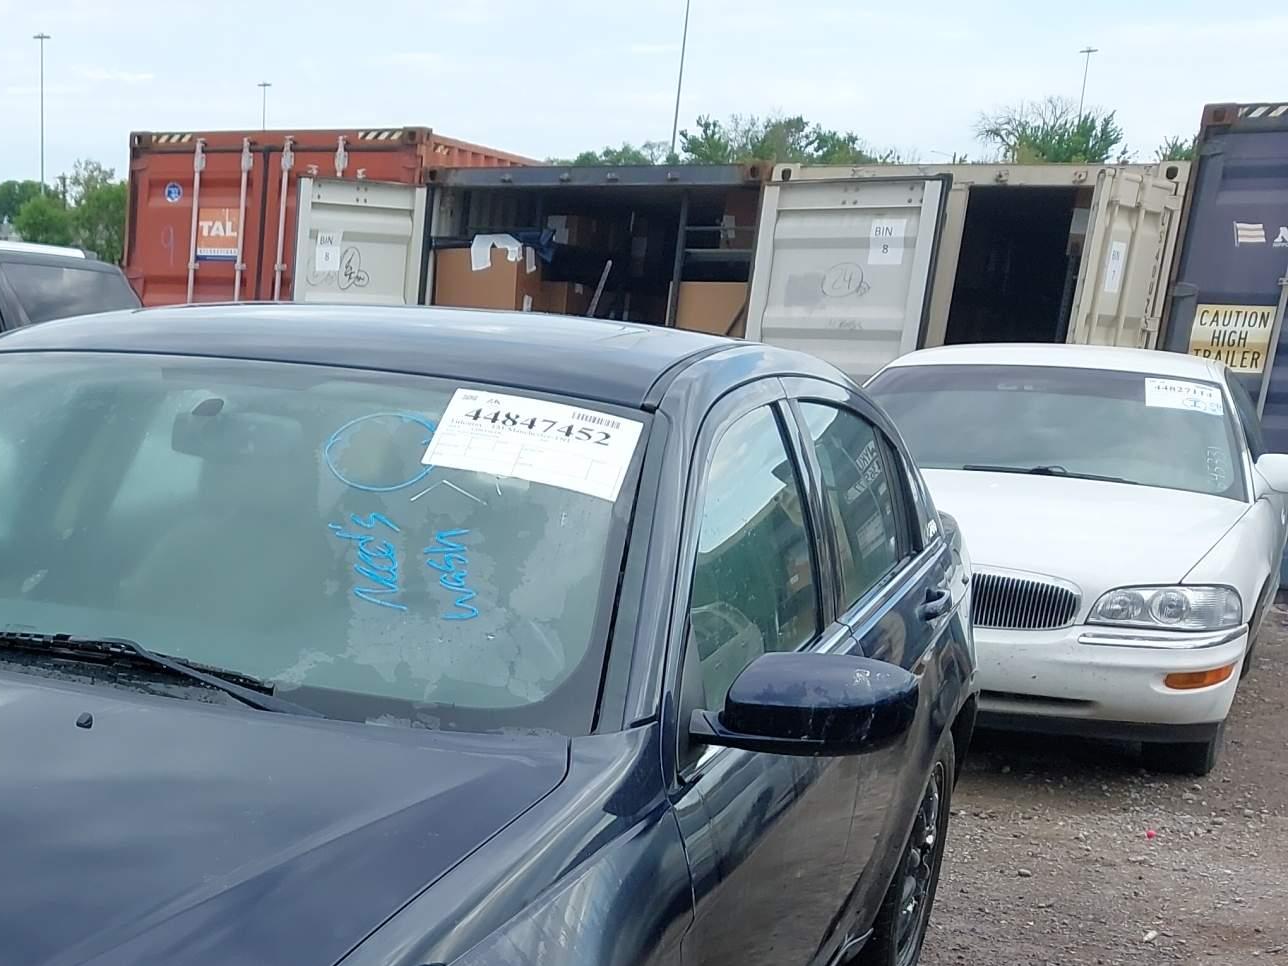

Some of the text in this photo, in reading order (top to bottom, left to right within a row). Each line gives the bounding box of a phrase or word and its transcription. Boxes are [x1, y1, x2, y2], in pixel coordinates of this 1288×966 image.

[199, 221, 238, 237] TAL
[874, 226, 893, 237] BIN
[881, 244, 889, 254] 8
[1199, 309, 1271, 329] CAUTION
[1210, 330, 1250, 349] HIGH
[464, 407, 612, 447] 44847452
